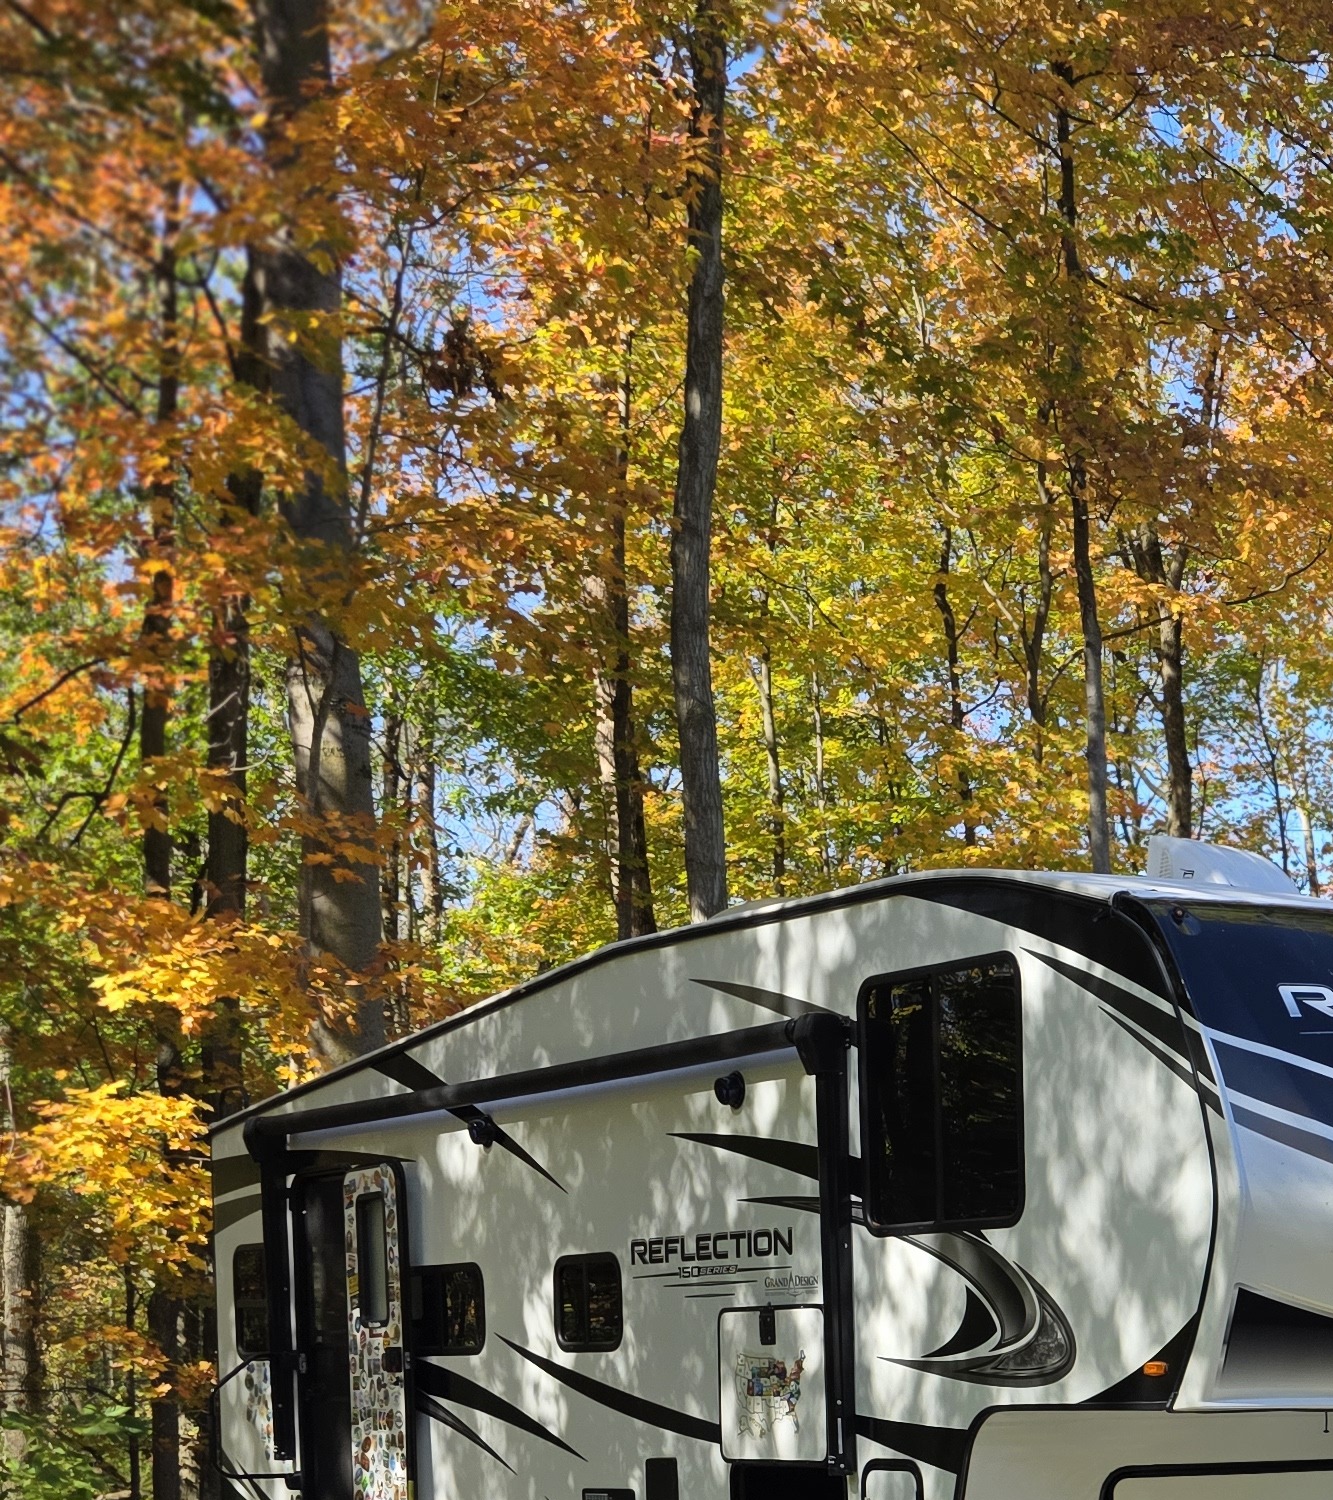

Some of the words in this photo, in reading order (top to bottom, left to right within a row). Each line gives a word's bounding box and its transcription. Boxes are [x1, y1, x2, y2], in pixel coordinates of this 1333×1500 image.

[631, 1227, 793, 1265] REFLECTION
[678, 1266, 700, 1278] 150
[700, 1265, 737, 1275] SERIES
[765, 1277, 788, 1288] GRAND
[795, 1275, 819, 1287] DESIGN
